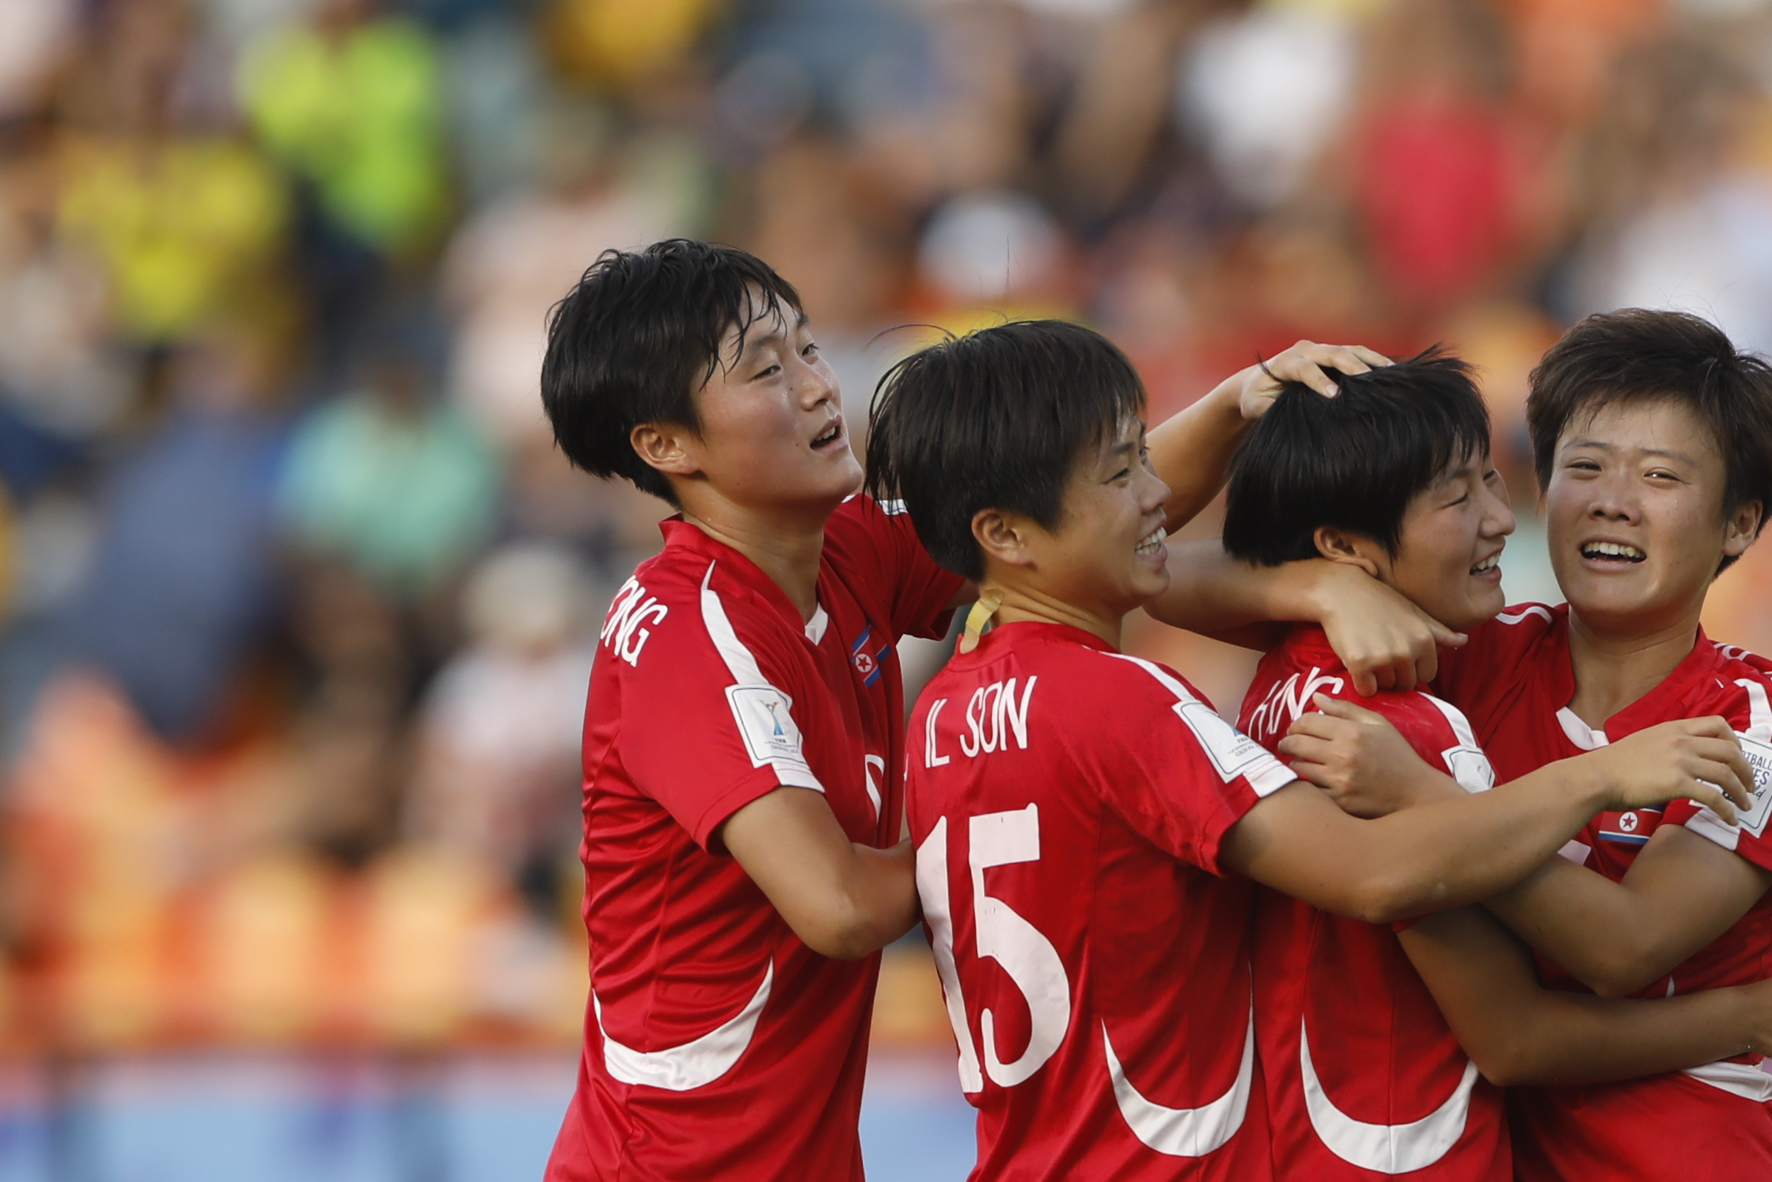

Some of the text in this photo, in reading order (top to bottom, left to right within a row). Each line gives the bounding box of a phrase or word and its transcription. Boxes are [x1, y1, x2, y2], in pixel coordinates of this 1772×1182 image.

[600, 575, 669, 668] ONG
[925, 675, 1038, 769] IL SON
[916, 802, 1071, 1094] 15
